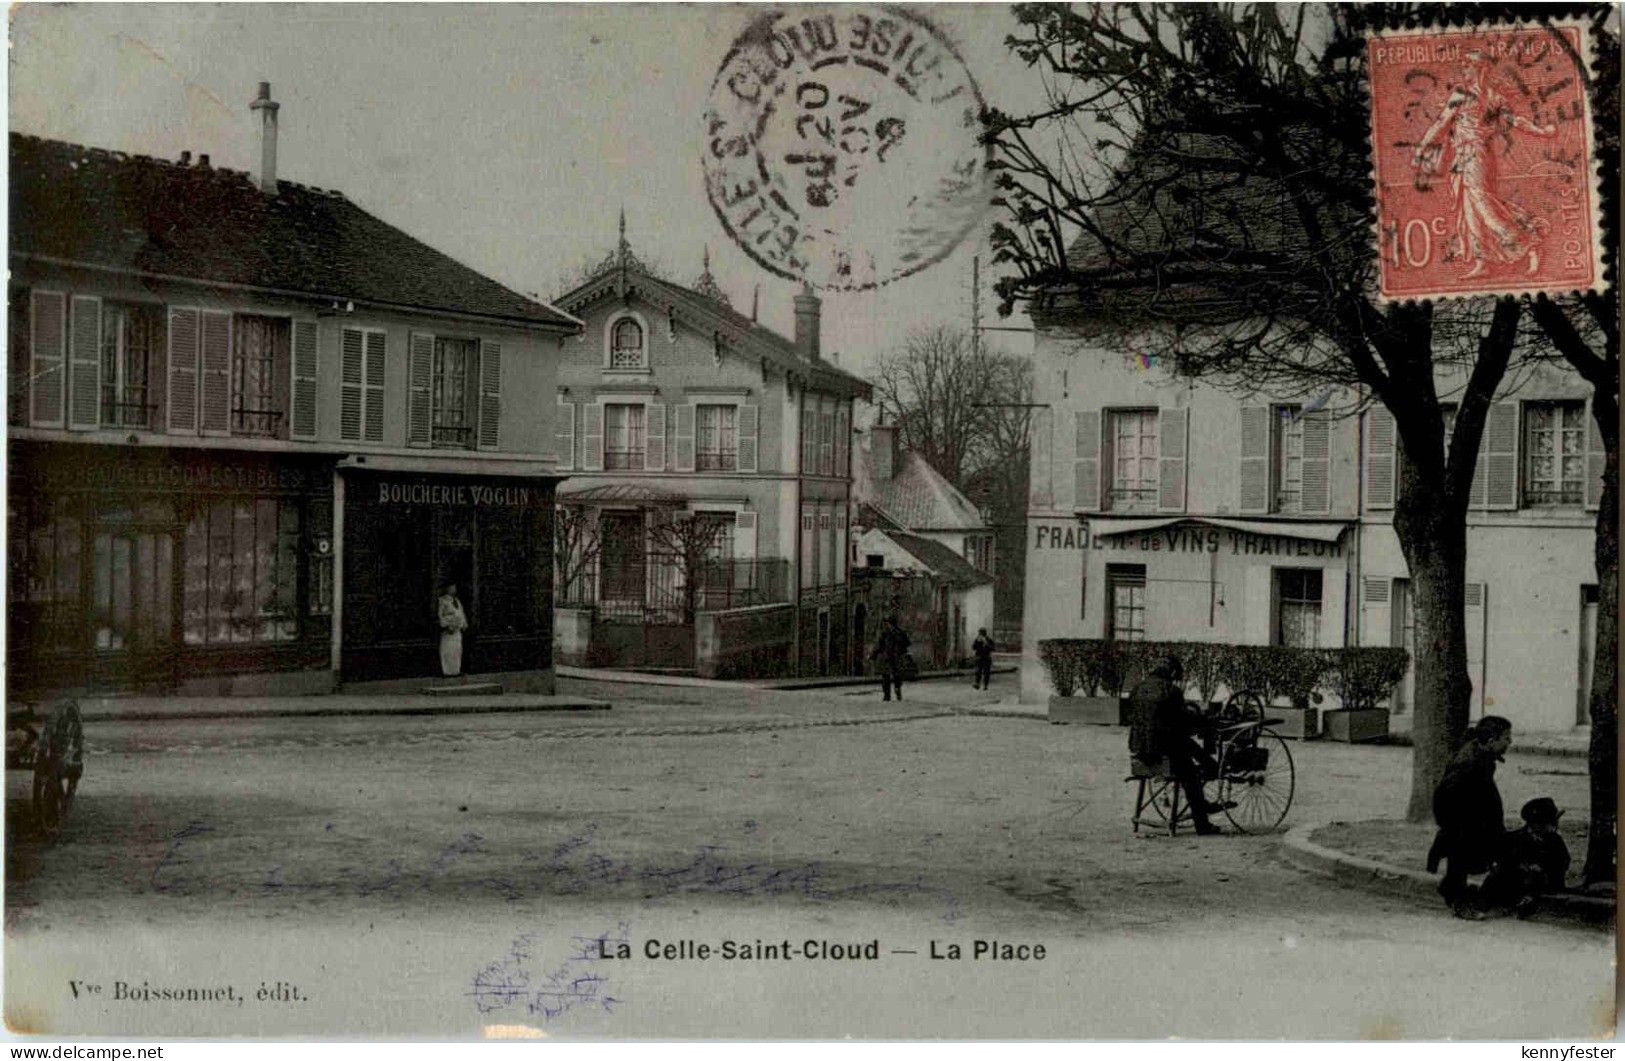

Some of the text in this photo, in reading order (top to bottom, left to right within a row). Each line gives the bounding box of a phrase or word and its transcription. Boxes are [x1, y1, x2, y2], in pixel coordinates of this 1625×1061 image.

[379, 482, 528, 505] BOUCHERIE VOGLIN
[1141, 534, 1161, 551] de
[1166, 529, 1219, 553] VINS
